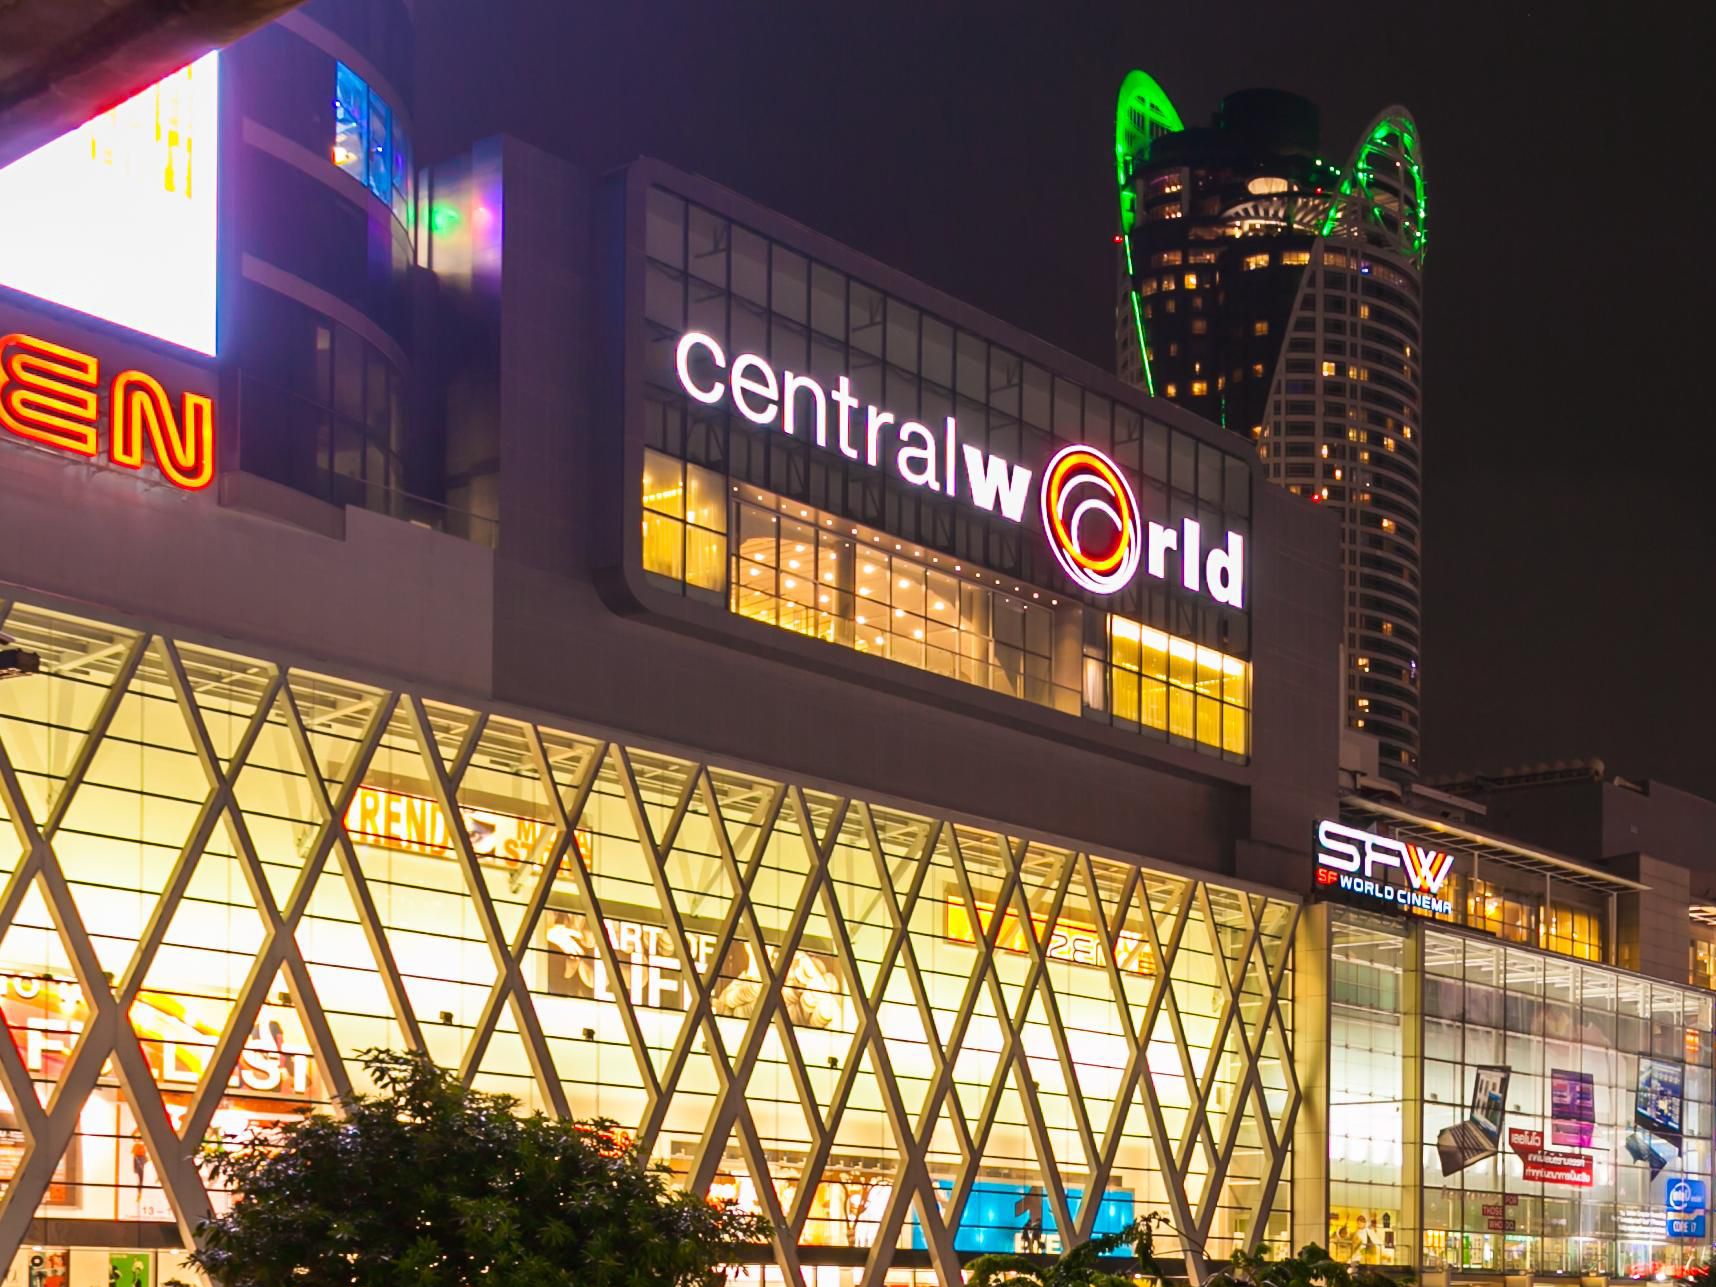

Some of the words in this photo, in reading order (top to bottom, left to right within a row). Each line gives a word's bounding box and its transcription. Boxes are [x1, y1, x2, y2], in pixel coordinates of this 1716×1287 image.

[675, 332, 1244, 608] centralworld
[1318, 868, 1338, 884] SF
[1340, 875, 1394, 900] WORLD
[1397, 890, 1452, 914] CINEMA
